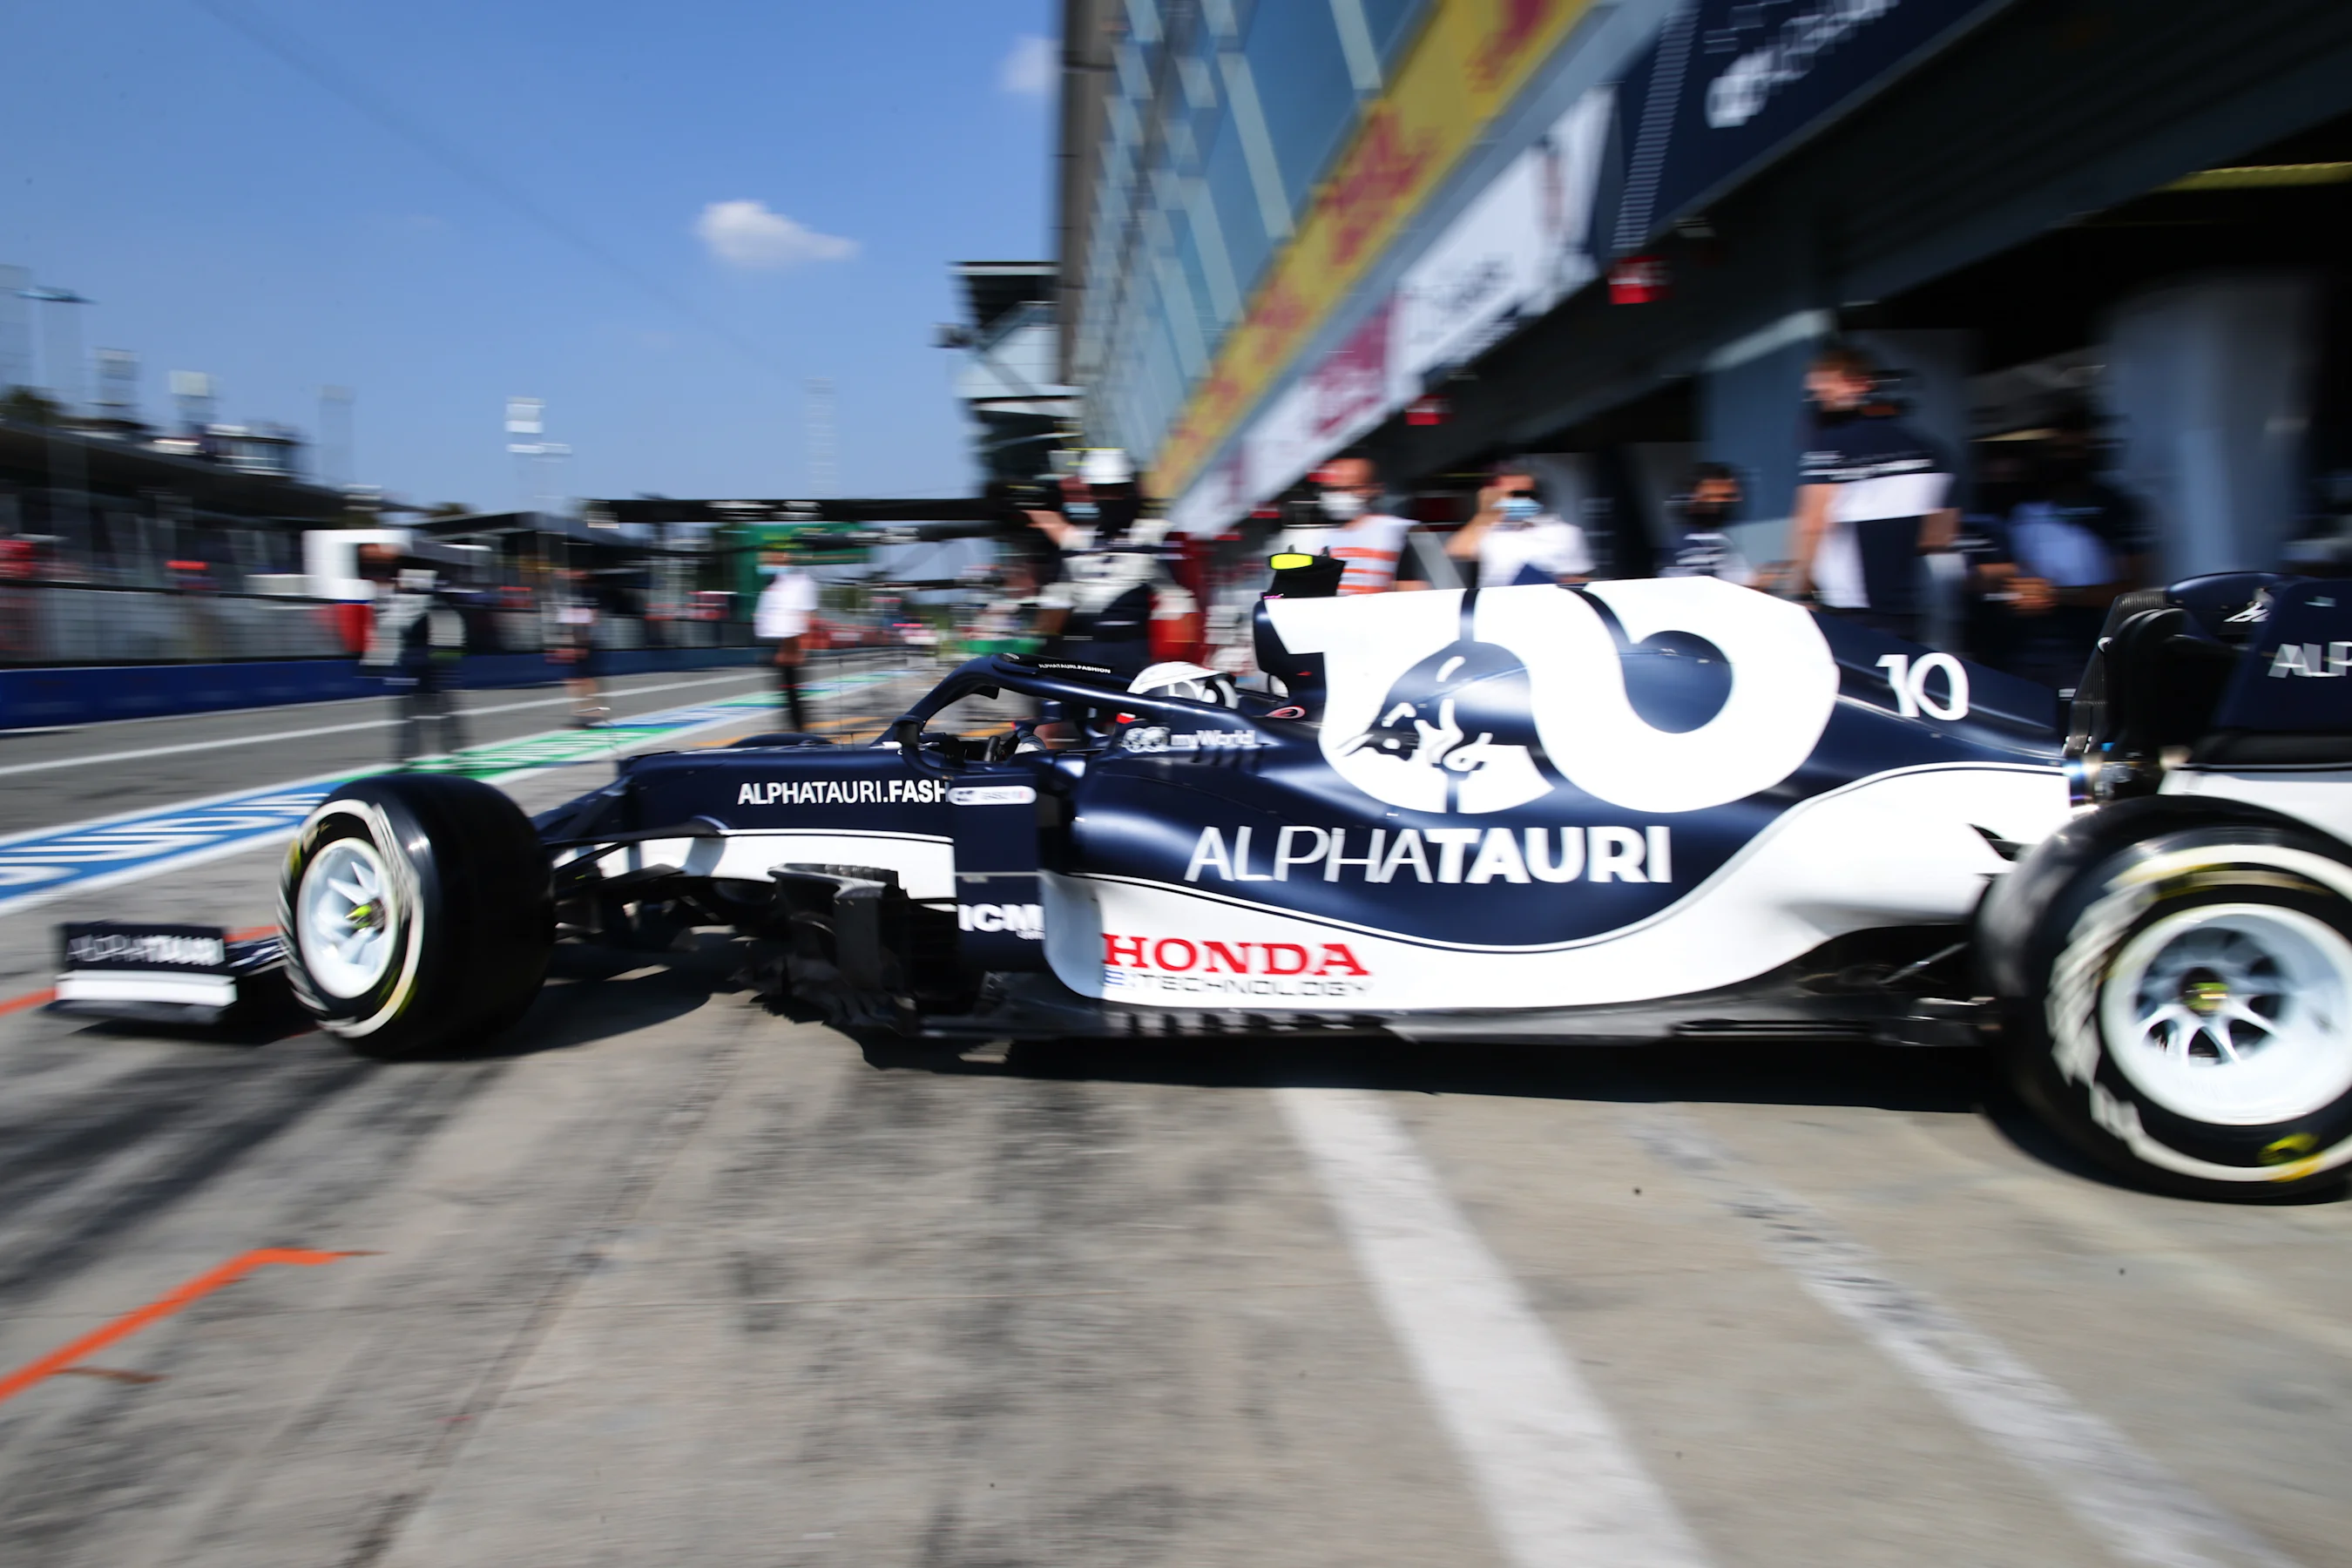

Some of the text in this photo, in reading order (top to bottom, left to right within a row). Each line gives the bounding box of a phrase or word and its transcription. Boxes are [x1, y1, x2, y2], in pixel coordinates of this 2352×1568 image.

[1875, 652, 1970, 721] 10
[1184, 825, 1673, 884] ALPHATAURI
[1102, 933, 1370, 976] HONDA
